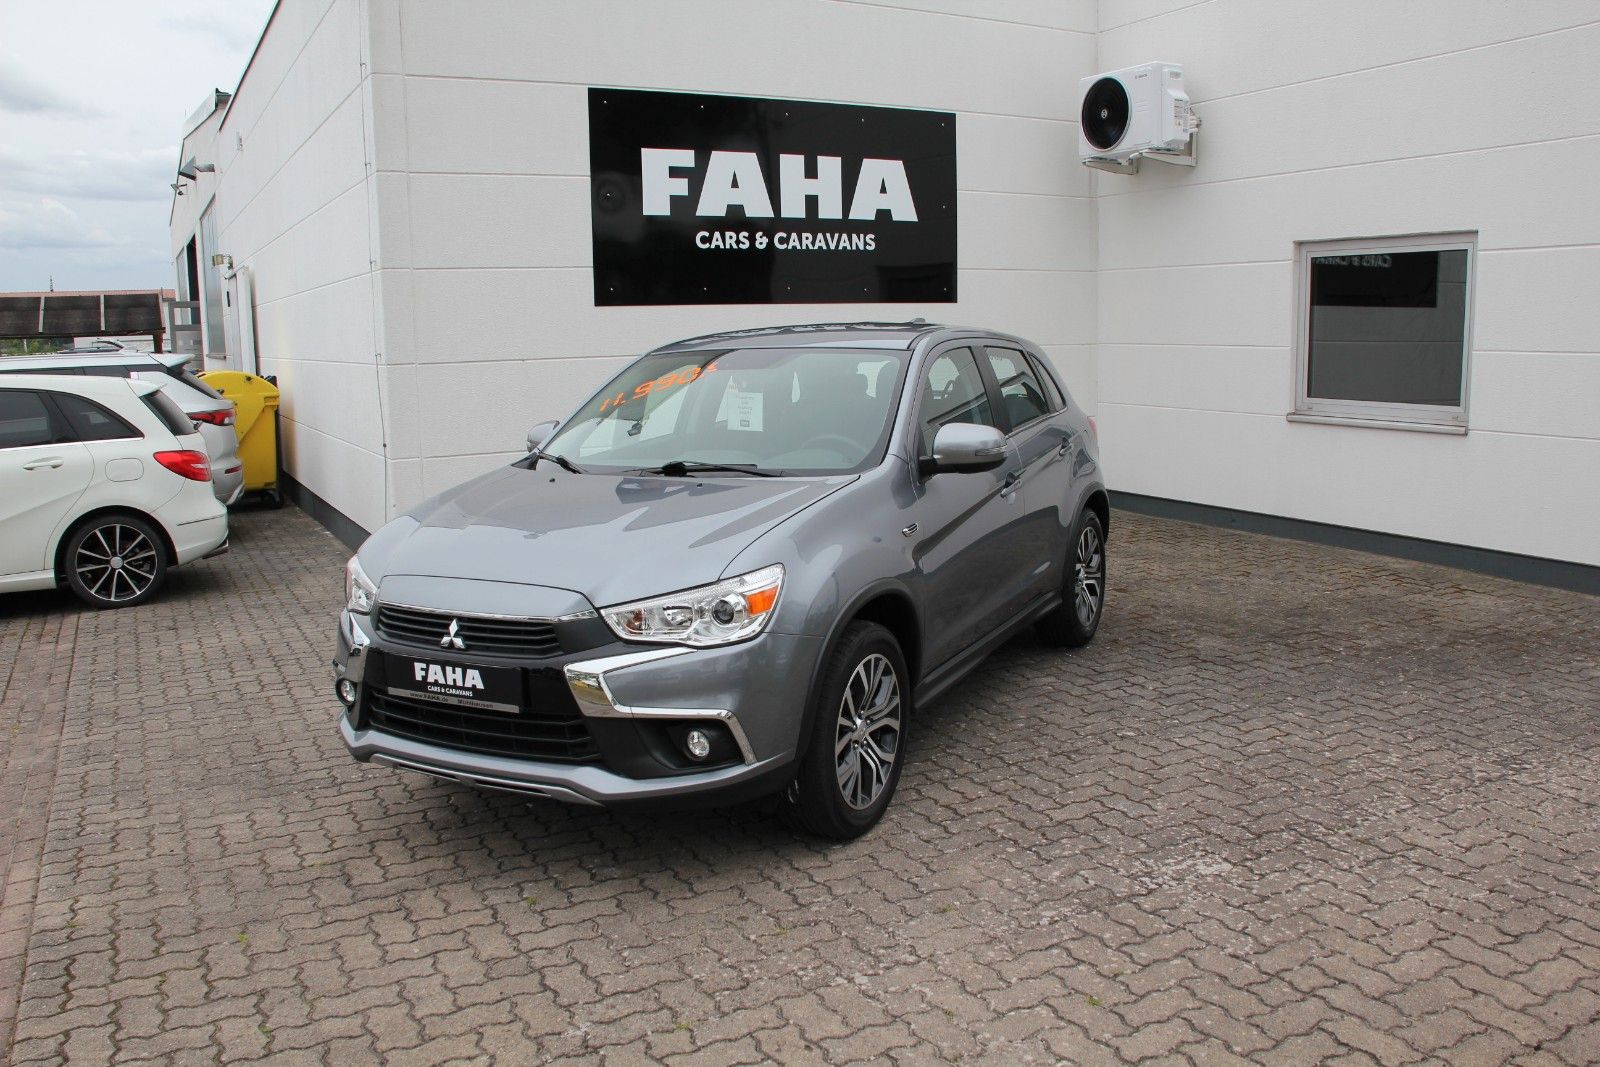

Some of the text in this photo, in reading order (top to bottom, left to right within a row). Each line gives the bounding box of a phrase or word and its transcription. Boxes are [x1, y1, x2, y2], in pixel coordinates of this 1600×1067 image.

[641, 147, 919, 222] FAHA
[695, 231, 876, 251] CARS & CARAVANS
[413, 661, 485, 690] FAHA
[427, 685, 441, 693] CARS
[445, 687, 473, 697] CARAVANS
